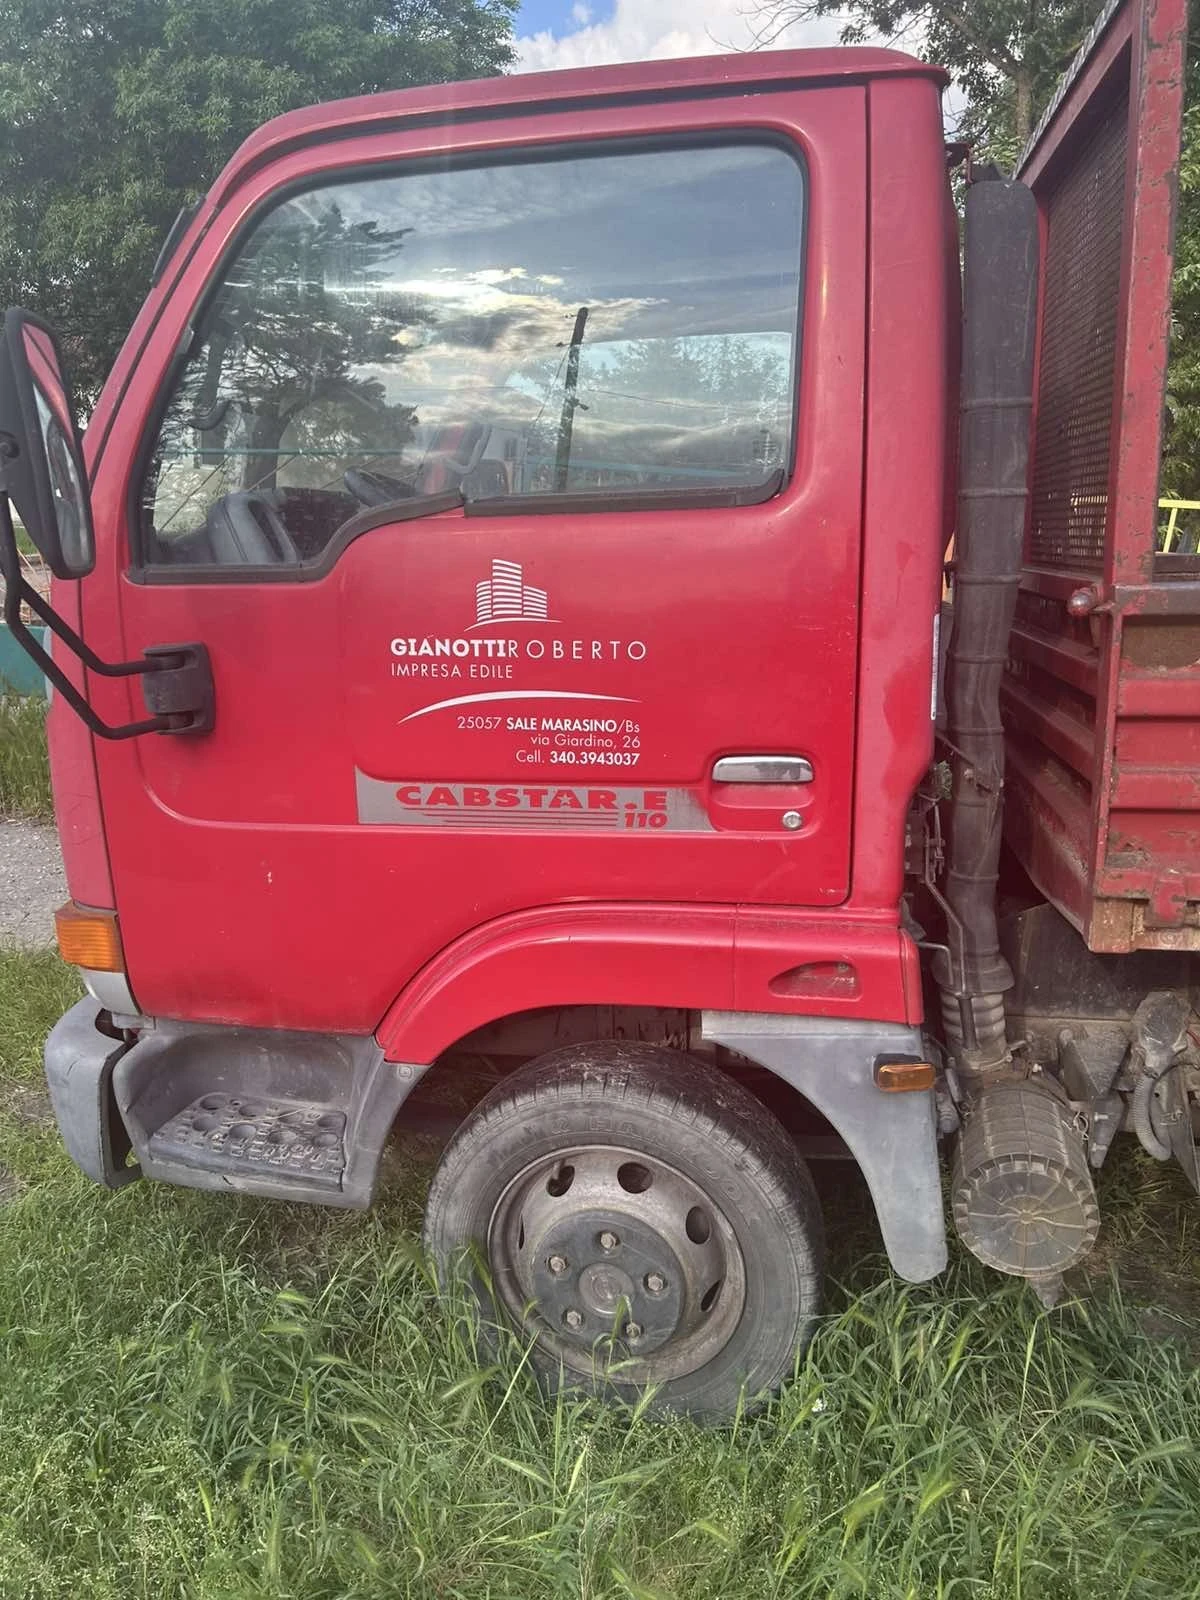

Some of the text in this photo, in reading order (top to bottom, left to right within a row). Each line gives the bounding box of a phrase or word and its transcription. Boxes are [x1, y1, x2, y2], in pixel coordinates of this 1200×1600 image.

[391, 662, 513, 679] IMPRESA EDILE
[457, 715, 640, 735] 25057 SALE MARASINO/Bs
[530, 733, 641, 750] via Giardino, 26
[515, 749, 641, 766] Cell. 340.3943037
[624, 811, 668, 829] 110
